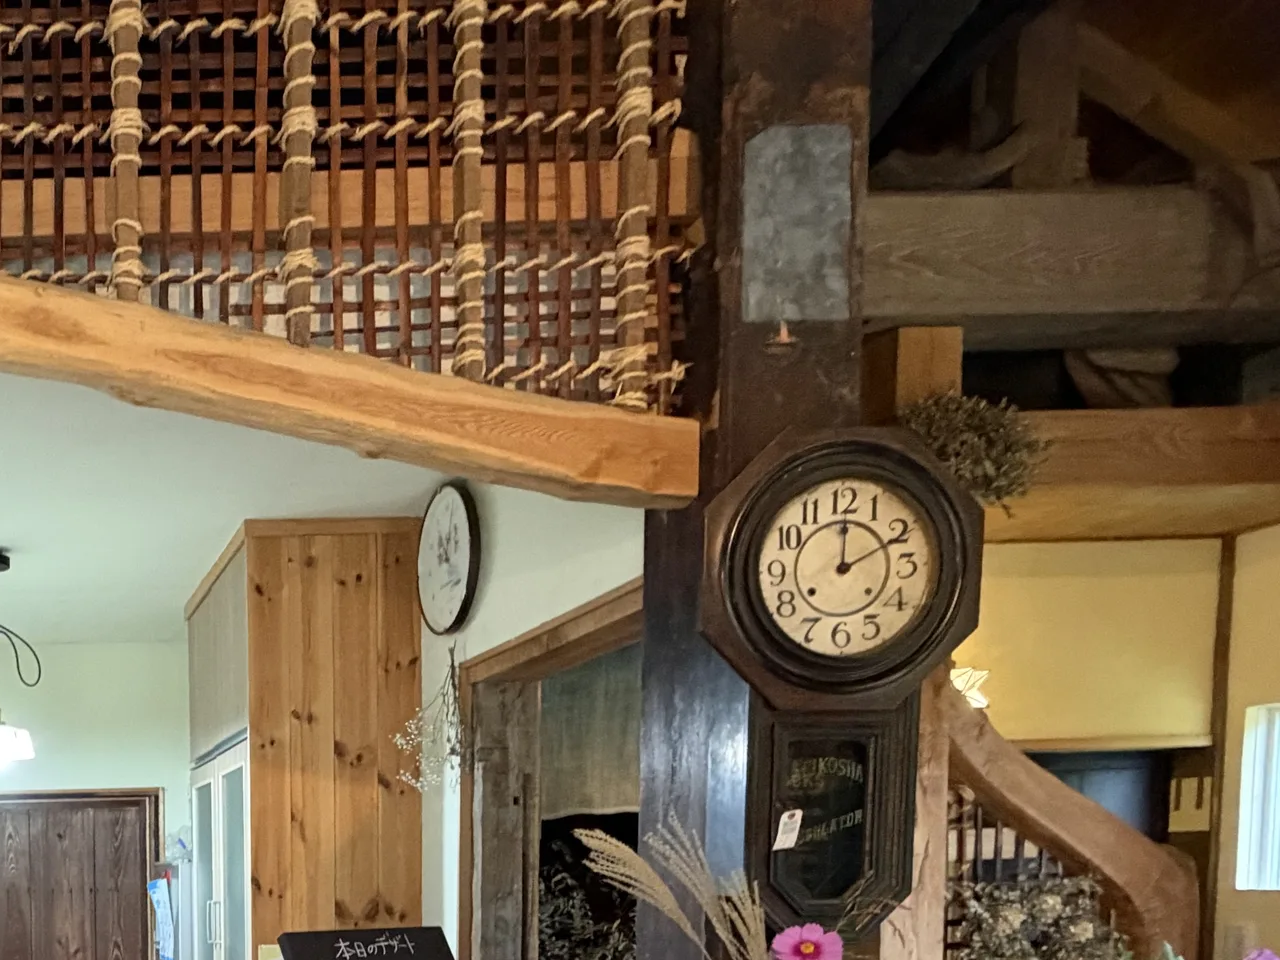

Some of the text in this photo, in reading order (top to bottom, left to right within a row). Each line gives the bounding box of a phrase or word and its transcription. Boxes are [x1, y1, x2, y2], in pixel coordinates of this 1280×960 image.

[800, 498, 819, 525] 11
[830, 487, 860, 515] 12
[869, 494, 879, 521] 1
[777, 524, 802, 551] 10
[887, 518, 911, 545] 2
[767, 559, 786, 587] 9
[895, 552, 918, 579] 3
[776, 590, 797, 618] 8
[882, 586, 909, 612] 4
[800, 616, 822, 643] 7
[830, 621, 851, 649] 6
[861, 613, 881, 640] 5
[334, 932, 416, 960] 本日のデザート
